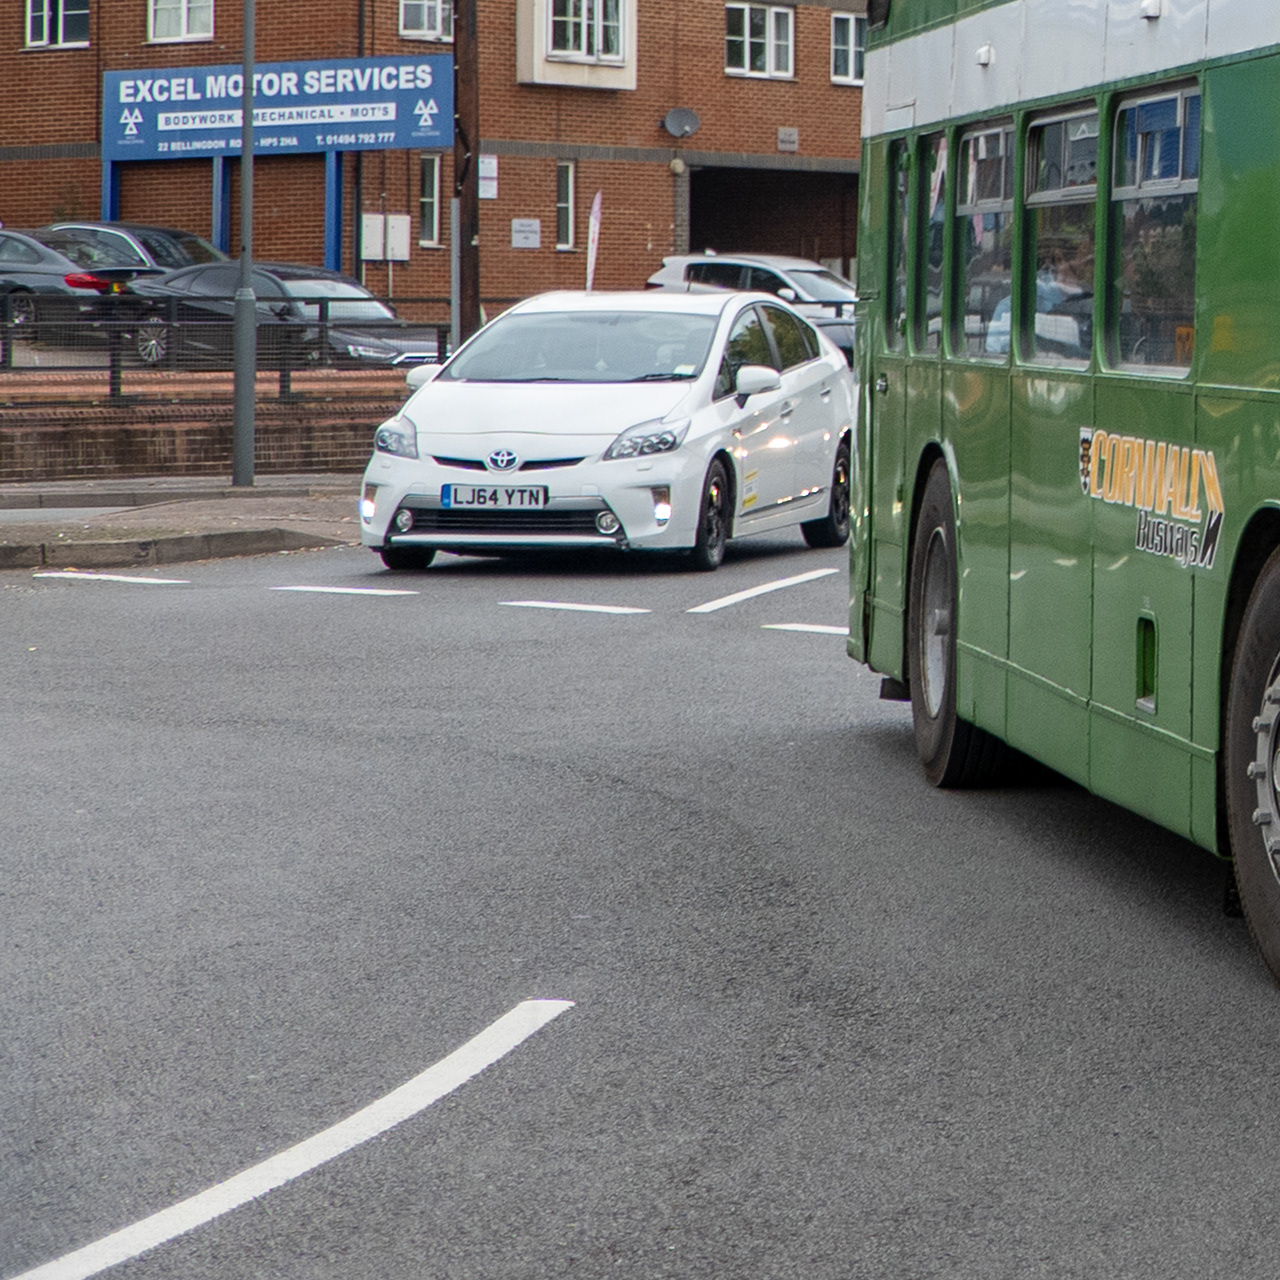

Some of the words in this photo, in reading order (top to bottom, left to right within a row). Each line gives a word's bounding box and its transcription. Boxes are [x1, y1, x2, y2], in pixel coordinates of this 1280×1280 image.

[119, 77, 201, 104] EXCEL
[303, 64, 433, 95] SERVICES
[164, 113, 236, 127] BODYWORK
[350, 106, 390, 118] MOT'S
[358, 132, 377, 145] 792
[378, 131, 397, 144] 777
[1090, 429, 1203, 524] CORNWALL
[453, 487, 499, 506] LJ64
[504, 488, 541, 506] YTN
[1136, 508, 1201, 569] Busways
